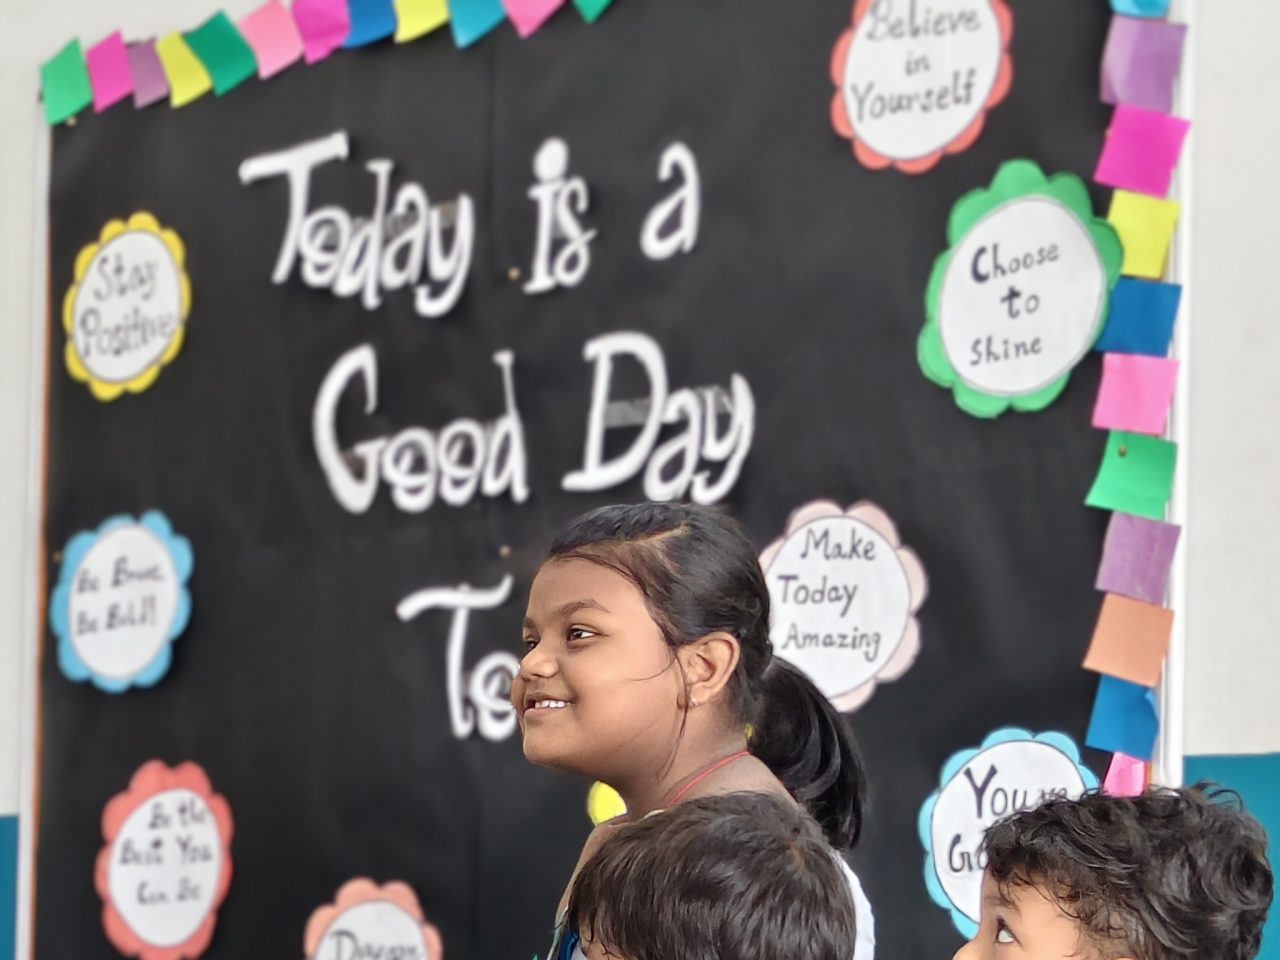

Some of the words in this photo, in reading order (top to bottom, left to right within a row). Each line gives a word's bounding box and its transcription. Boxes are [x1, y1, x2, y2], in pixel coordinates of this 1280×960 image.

[865, 0, 982, 42] Believe
[904, 50, 931, 77] in
[850, 66, 977, 124] Yourself
[236, 128, 475, 318] Today
[523, 136, 597, 294] is
[640, 141, 701, 261] a
[92, 252, 159, 301] Stay
[970, 241, 1060, 284] Choose
[999, 285, 1041, 320] to
[79, 306, 173, 358] Positive
[312, 343, 529, 514] Good
[560, 330, 755, 505] Day
[800, 527, 876, 561] Make
[76, 567, 101, 595] Be
[777, 573, 859, 619] Today
[76, 609, 99, 636] Be
[781, 622, 881, 662] Amazing
[148, 801, 170, 830] Be
[175, 833, 214, 866] You
[176, 876, 200, 902] Be
